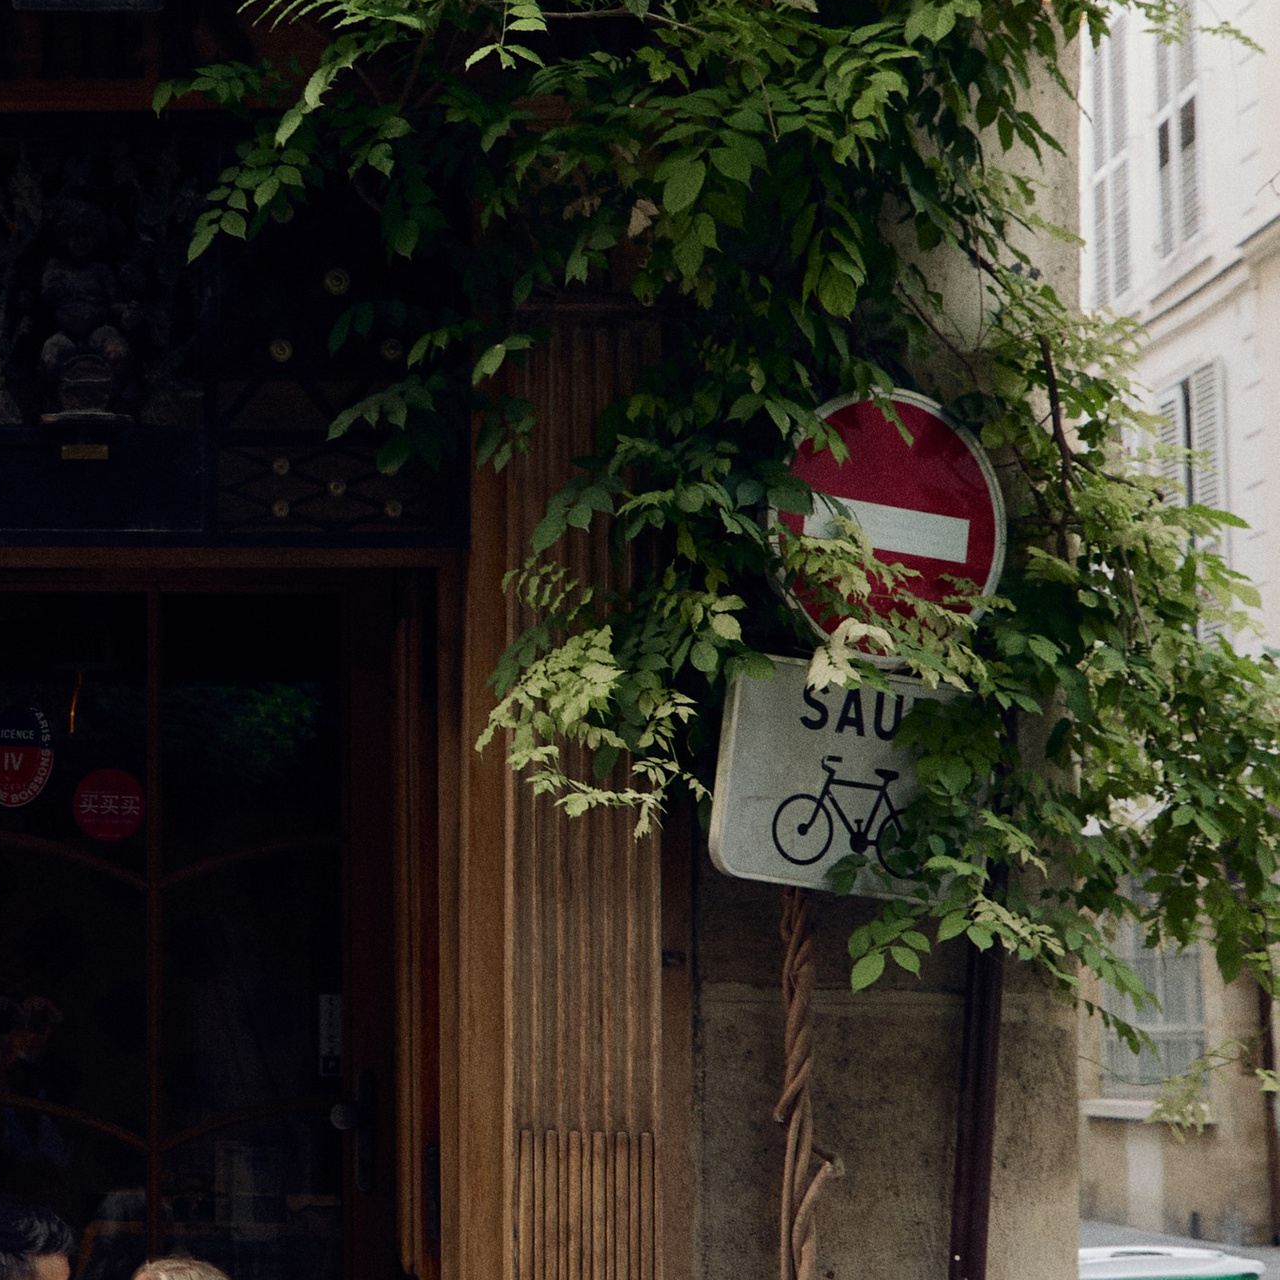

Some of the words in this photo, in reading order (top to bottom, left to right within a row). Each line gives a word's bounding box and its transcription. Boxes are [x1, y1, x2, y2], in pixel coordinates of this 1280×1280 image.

[29, 706, 51, 742] ARIS
[800, 684, 920, 741] SAU
[3, 751, 24, 771] IV
[10, 749, 51, 803] BOISSONS
[78, 793, 141, 815] 买买买
